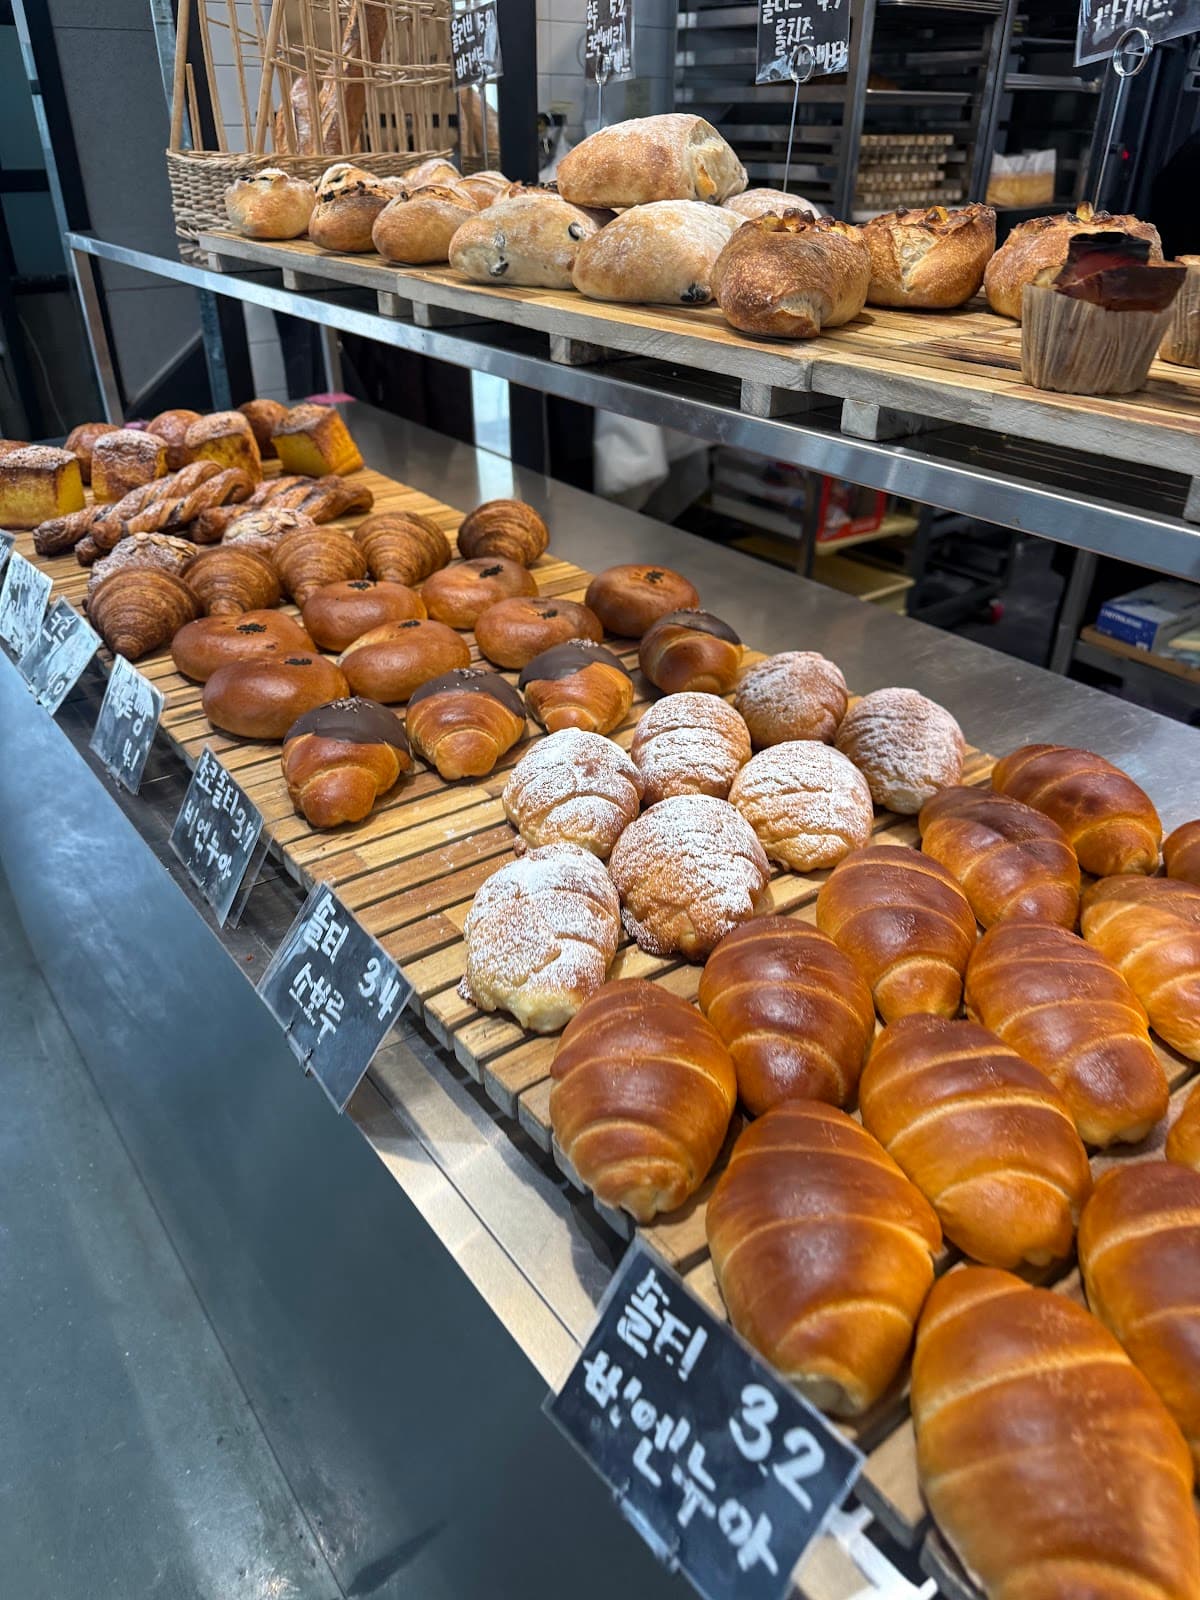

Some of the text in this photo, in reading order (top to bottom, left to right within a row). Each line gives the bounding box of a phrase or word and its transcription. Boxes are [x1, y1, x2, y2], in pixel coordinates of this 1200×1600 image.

[775, 16, 815, 56] 롤치즈
[231, 807, 256, 853] 3.7
[302, 892, 401, 1022] 솔티 3.4
[288, 961, 346, 1045] 소보루
[729, 1383, 826, 1513] 3.2
